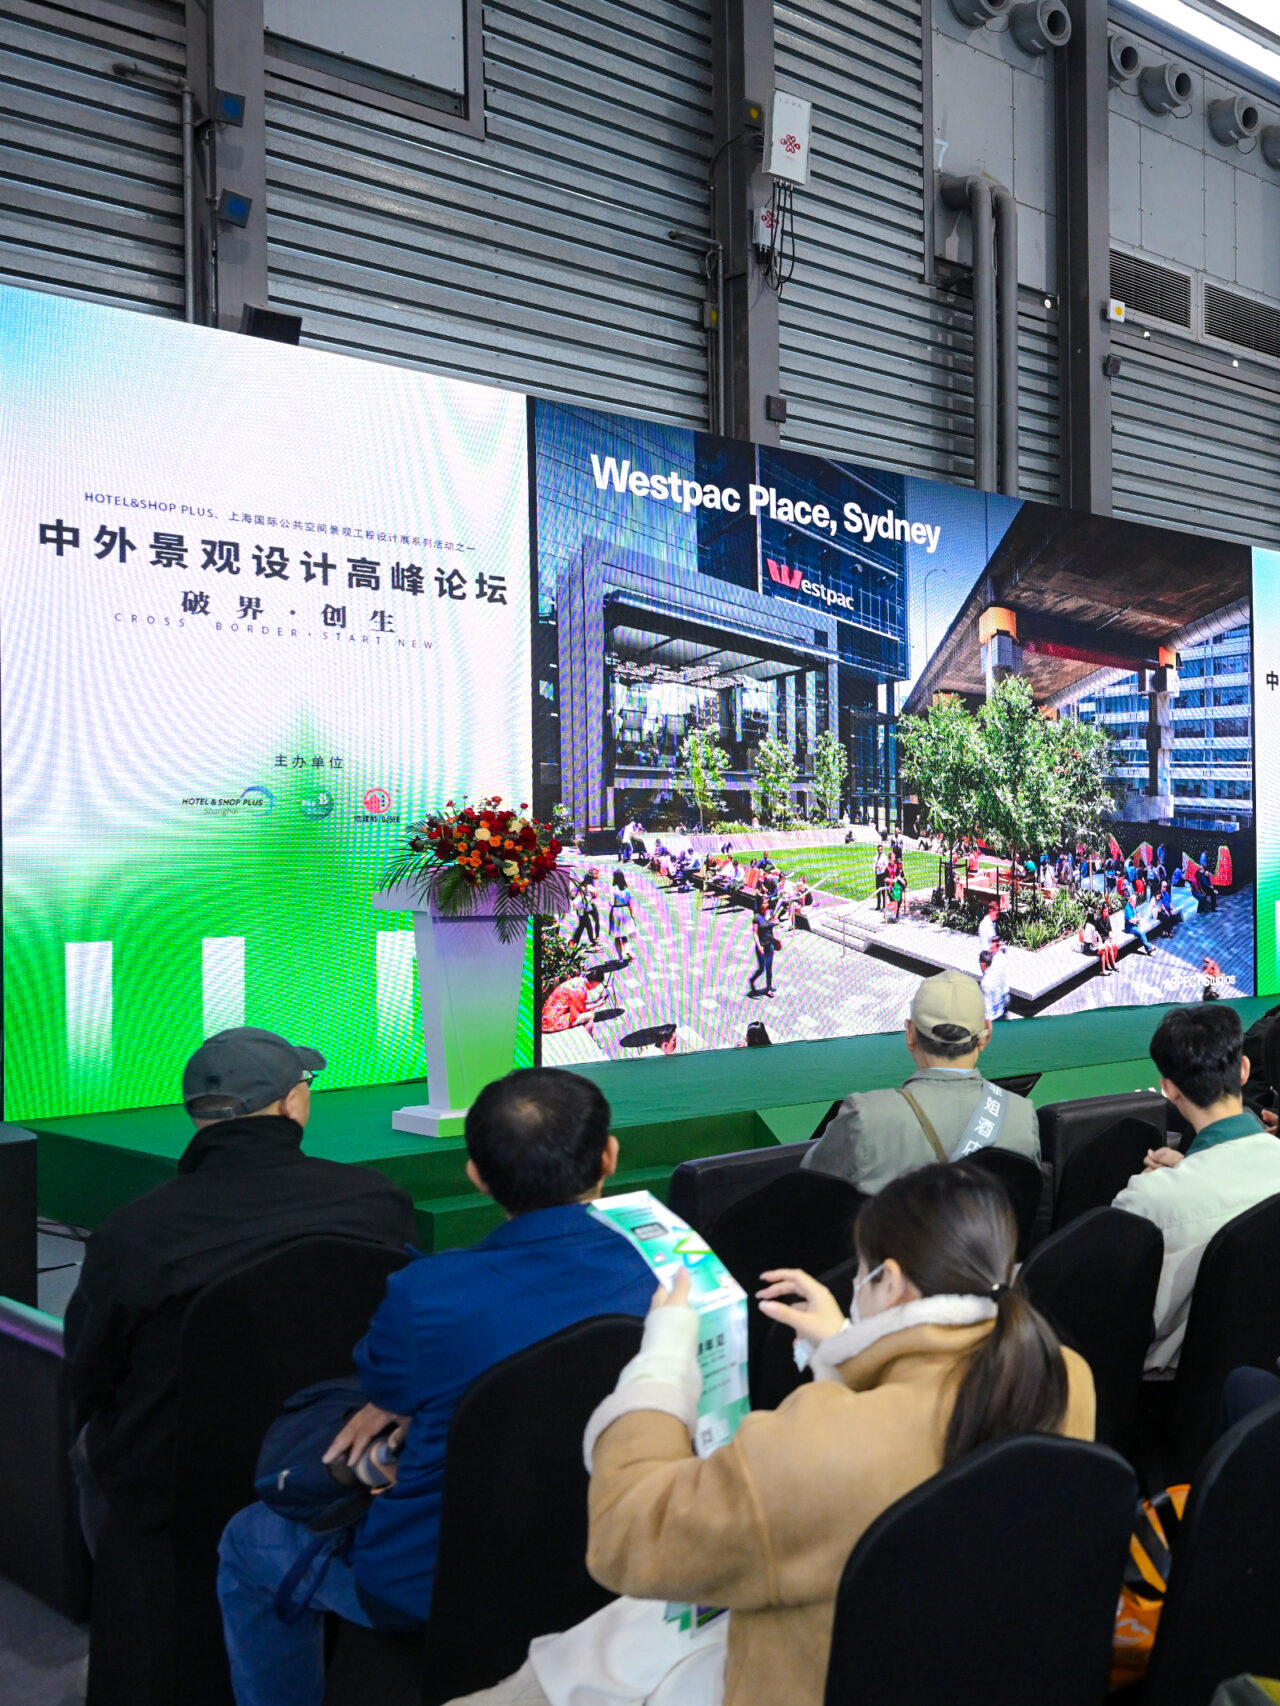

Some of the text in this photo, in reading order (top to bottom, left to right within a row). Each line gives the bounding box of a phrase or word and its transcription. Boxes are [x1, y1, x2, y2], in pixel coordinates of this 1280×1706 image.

[935, 137, 949, 168] 7
[85, 492, 176, 512] HOTEL&SHOP
[590, 453, 941, 553] Westpac Place, Sydney
[39, 518, 508, 606] 中外景观设计高峰论坛
[766, 558, 854, 609] Westpac
[114, 612, 185, 628] CROSS
[397, 637, 434, 650] NEW
[274, 754, 344, 769] 主办单位
[182, 798, 209, 806] HOTEL
[1203, 973, 1237, 987] Studios
